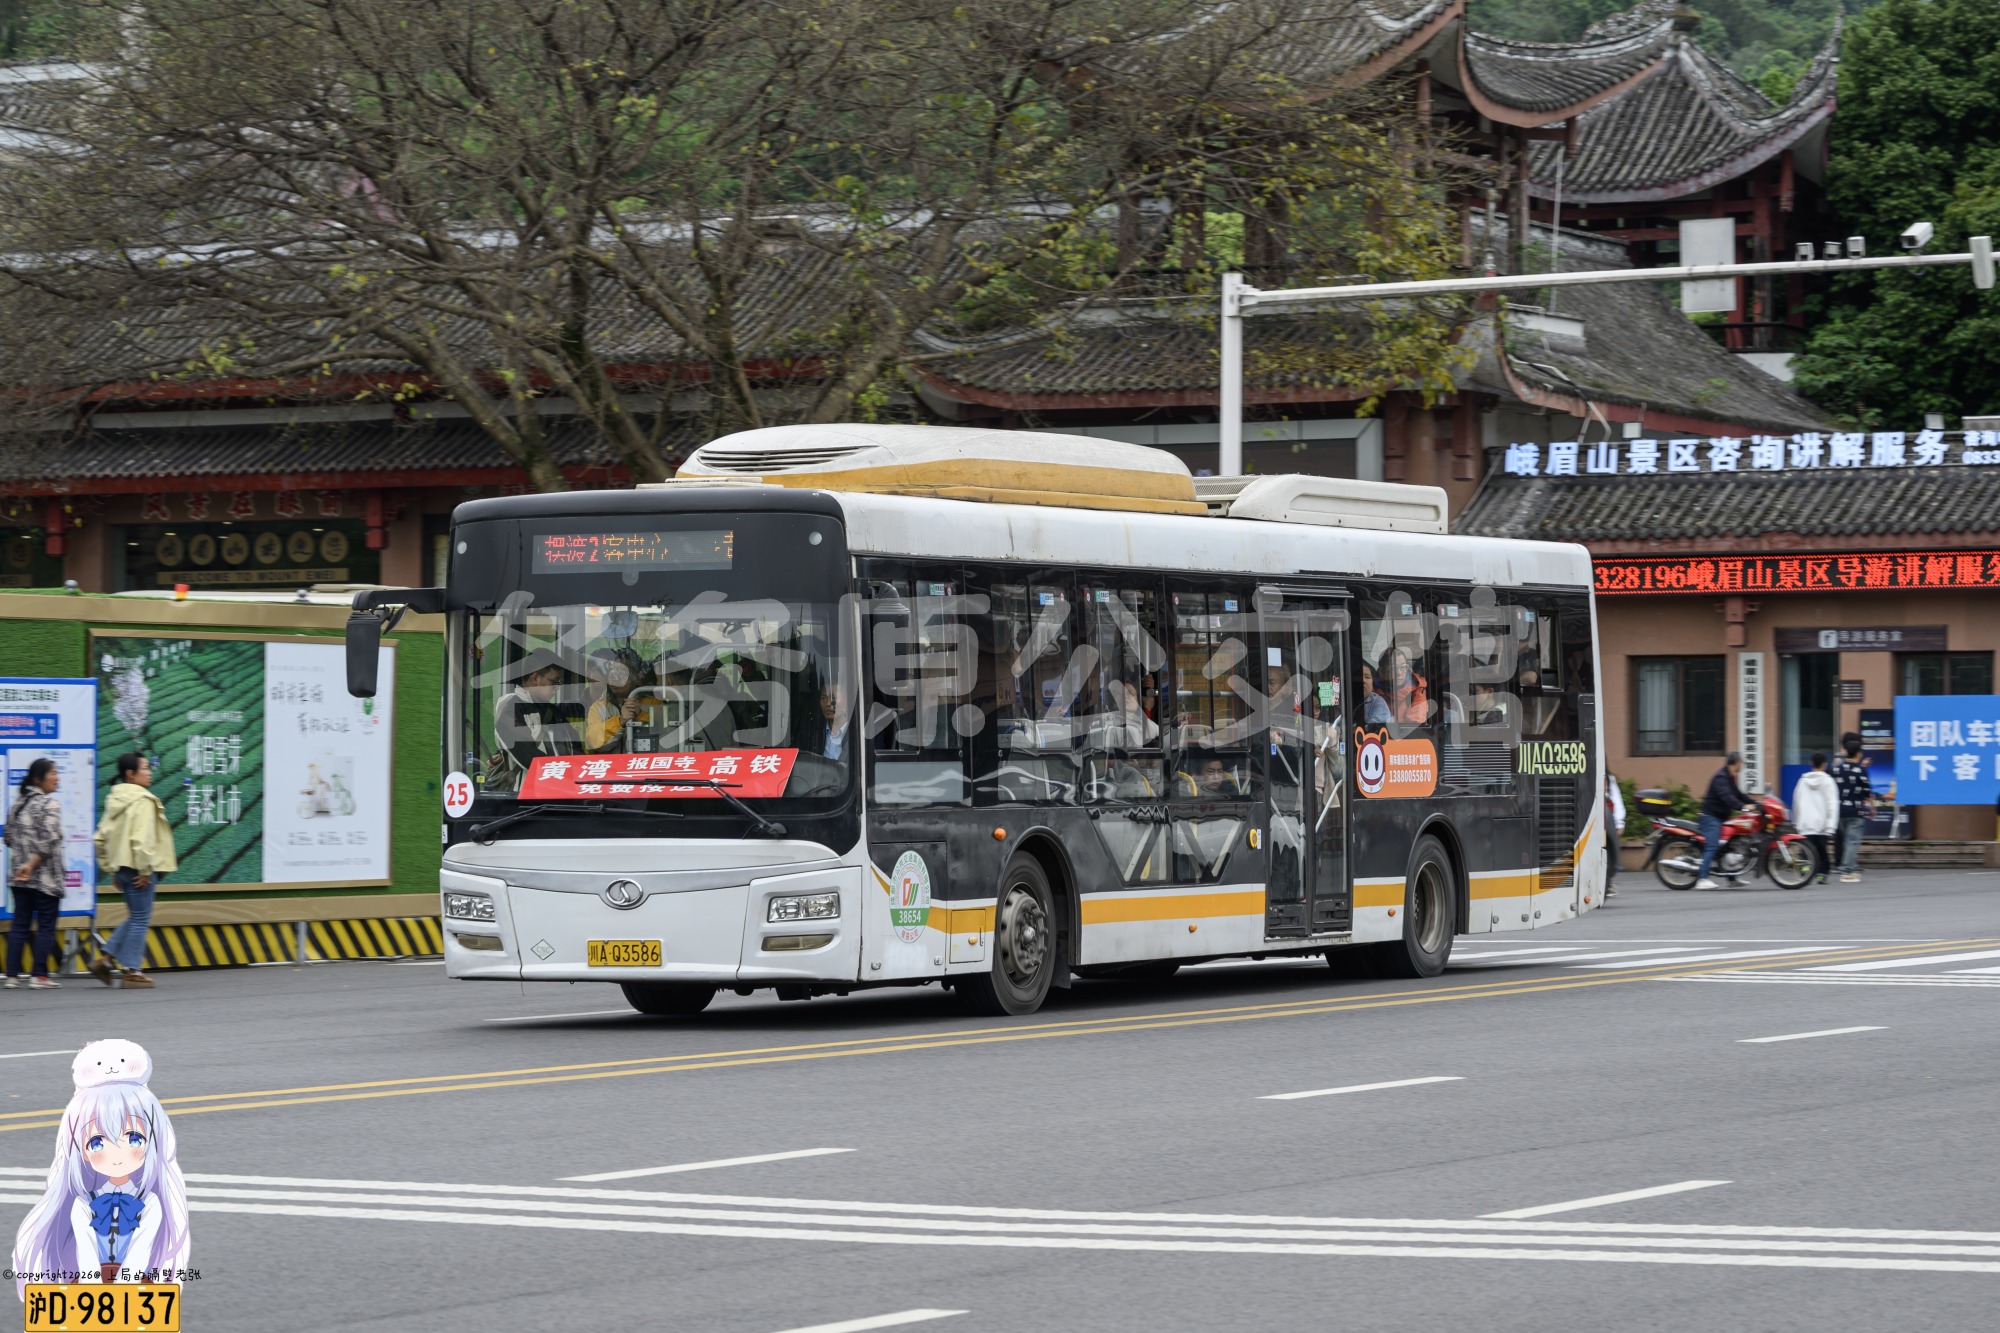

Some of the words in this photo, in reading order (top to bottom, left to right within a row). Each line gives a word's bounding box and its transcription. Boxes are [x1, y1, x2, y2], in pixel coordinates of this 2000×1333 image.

[1963, 430, 2000, 447] 咨询
[1504, 429, 1949, 476] 峨眉山景区咨询讲解服务
[1910, 720, 2000, 747] 团队车
[538, 760, 613, 780] 黄湾
[626, 756, 697, 770] 报国寺
[708, 754, 782, 775] 高铁
[1517, 742, 1586, 775] 川AQ3586
[1910, 753, 2000, 781] 下客
[1389, 769, 1431, 783] 13880055870
[447, 783, 468, 806] 25
[898, 910, 921, 923] 38654
